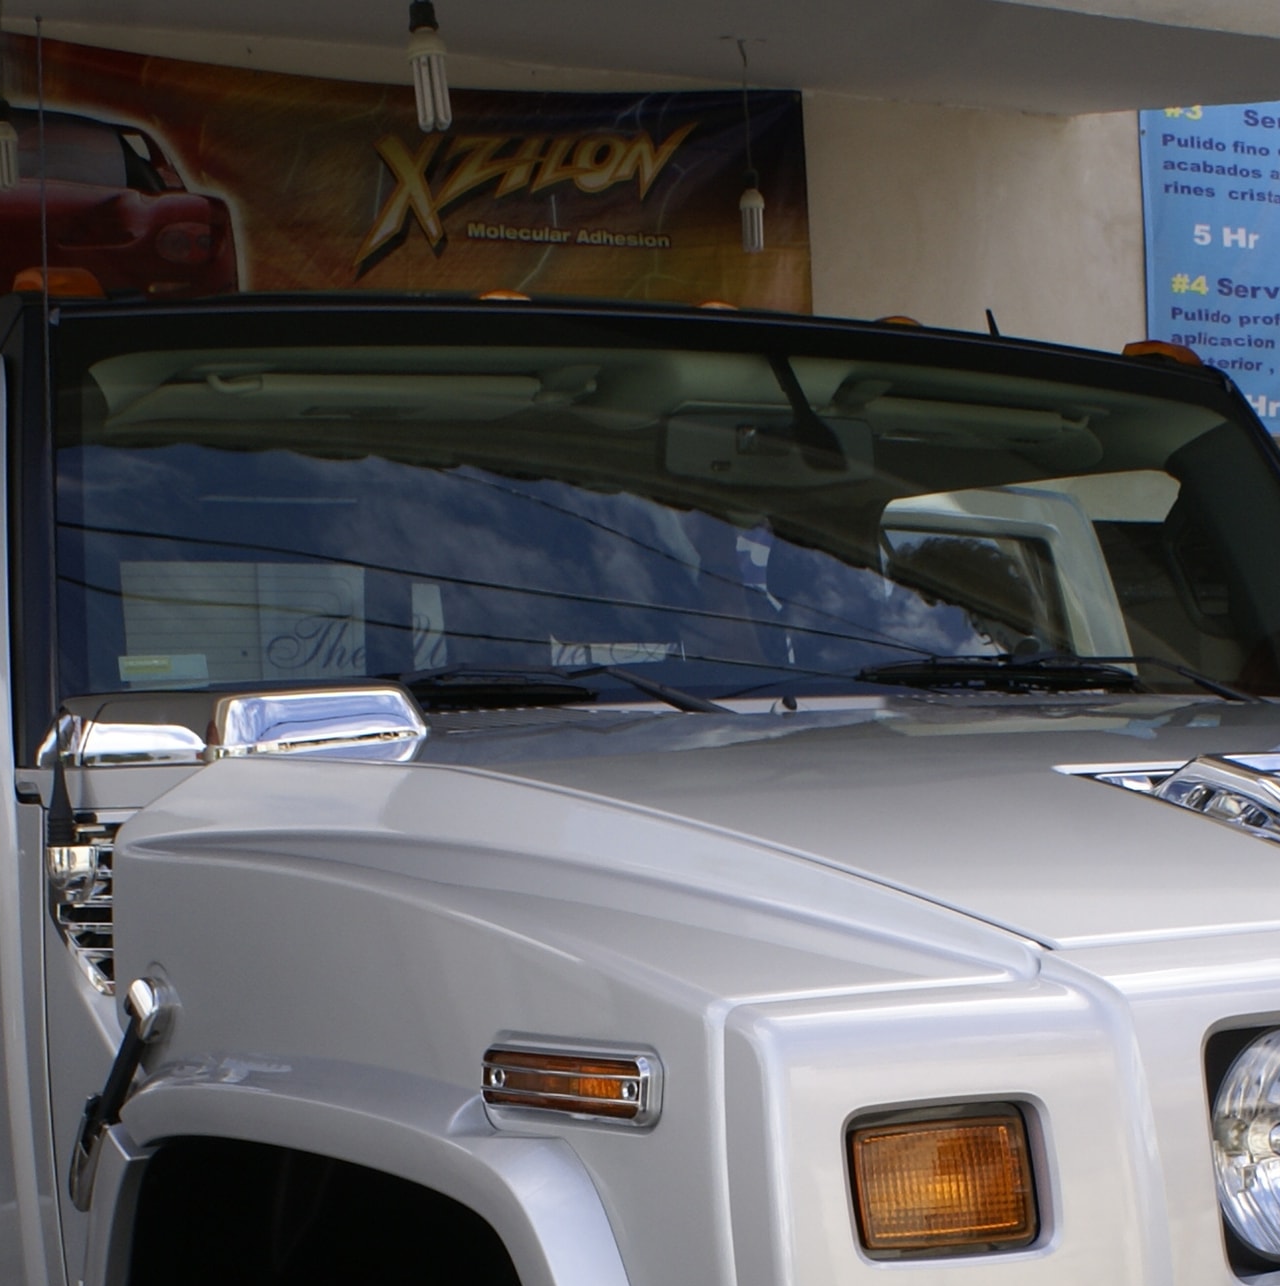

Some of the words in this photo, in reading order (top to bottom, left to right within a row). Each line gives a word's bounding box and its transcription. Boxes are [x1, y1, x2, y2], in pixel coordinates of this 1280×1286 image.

[1161, 133, 1226, 153] Pulido
[1233, 142, 1270, 157] fino
[1163, 158, 1262, 179] acabados
[1163, 181, 1216, 198] rines
[468, 222, 570, 244] Molecular
[576, 228, 671, 248] Adhesion
[1193, 223, 1212, 246] 5
[1223, 227, 1260, 249] Hr
[1171, 273, 1209, 295] #4
[1171, 307, 1232, 325] Pulido
[1170, 331, 1275, 350] aplicacion
[1202, 357, 1263, 372] terior
